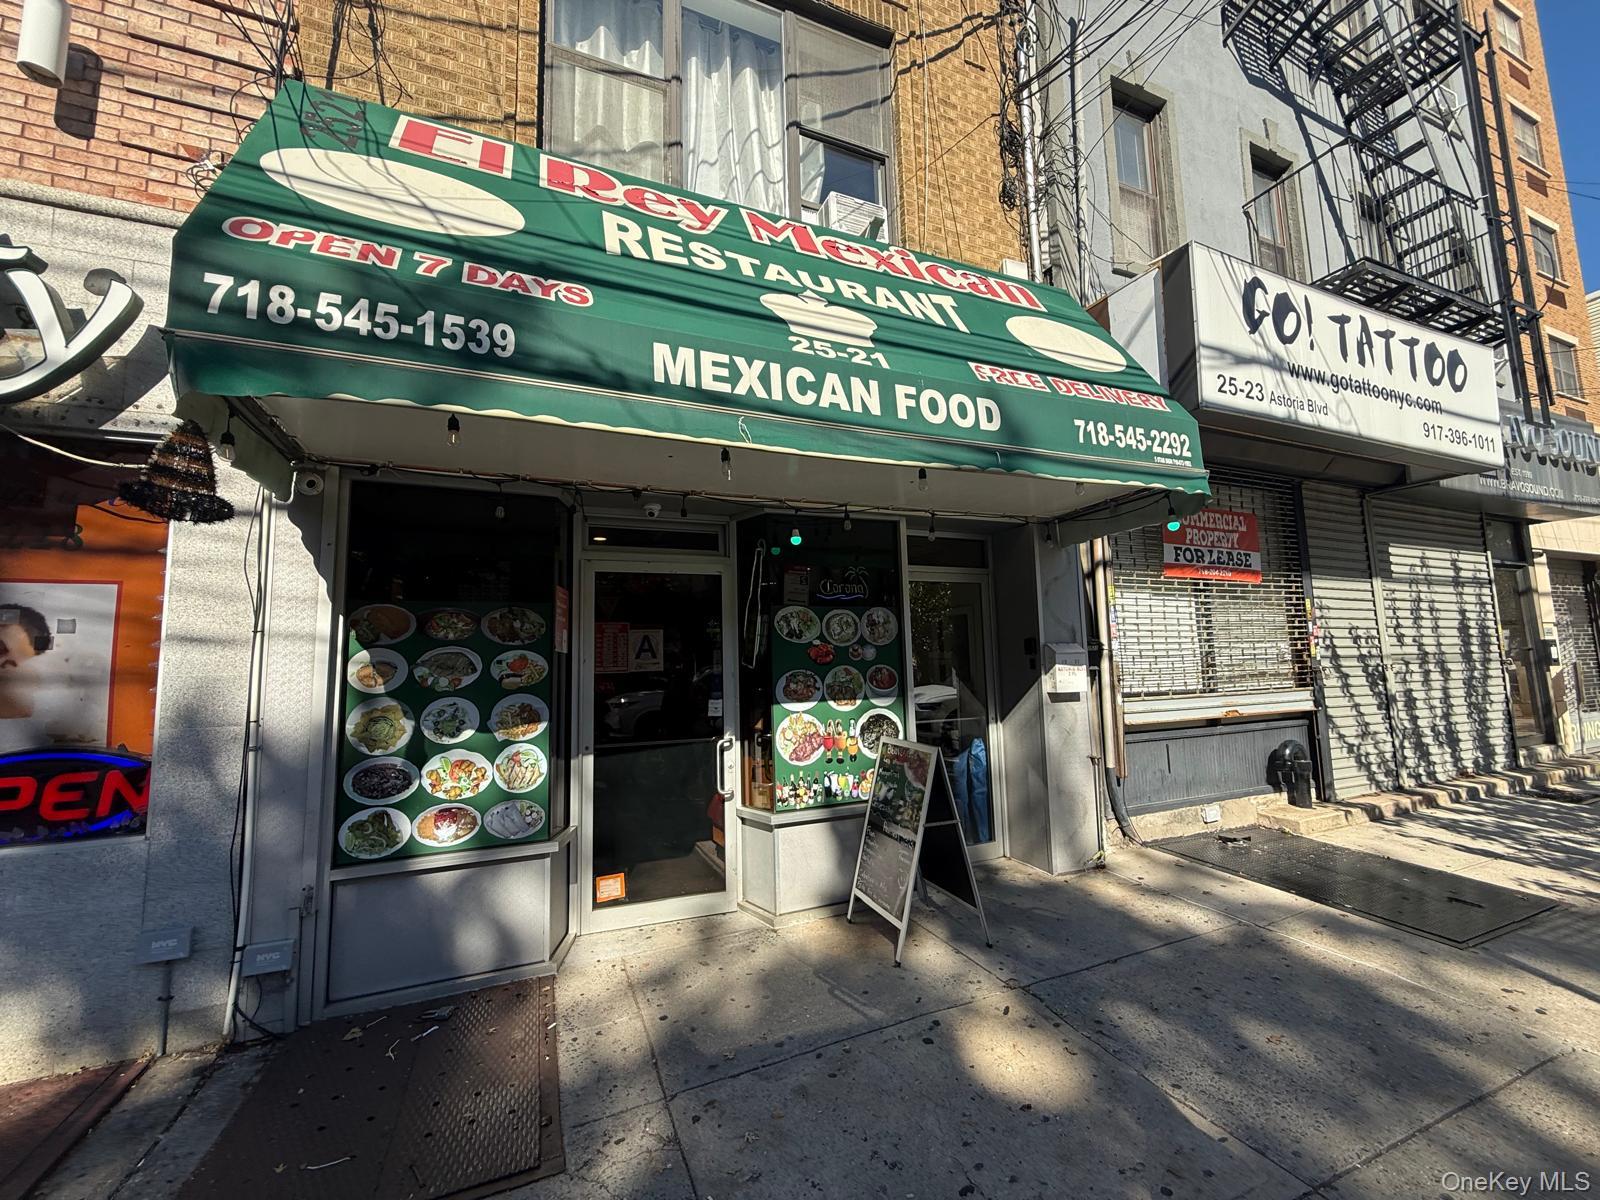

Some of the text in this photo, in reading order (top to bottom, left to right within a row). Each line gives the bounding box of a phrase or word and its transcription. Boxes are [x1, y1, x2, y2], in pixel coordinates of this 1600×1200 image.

[540, 153, 728, 235] Rey
[739, 206, 1048, 311] Mexican
[222, 216, 594, 307] OPEN 7 DAYS
[602, 210, 970, 333] RESTAURANT
[203, 272, 516, 358] 718-545-1539
[1242, 276, 1468, 393] GO! TATTOO
[787, 336, 890, 369] 25-21
[652, 342, 1001, 432] MEXICAN FOOD
[968, 361, 1172, 412] FREE DELIVERY
[1217, 373, 1329, 416] 25-23 Astoria Blvd
[1288, 361, 1443, 416] www.gotattoonyc.com
[1074, 419, 1192, 458] 718-545-2292
[1422, 422, 1496, 453] 917-396-1011
[1180, 511, 1247, 531] OMMERCIAL
[1185, 528, 1239, 548] PROPERTY
[1173, 546, 1252, 568] FOR LEASE
[819, 579, 864, 595] Corona
[634, 634, 658, 660] A
[256, 951, 281, 962] NYC
